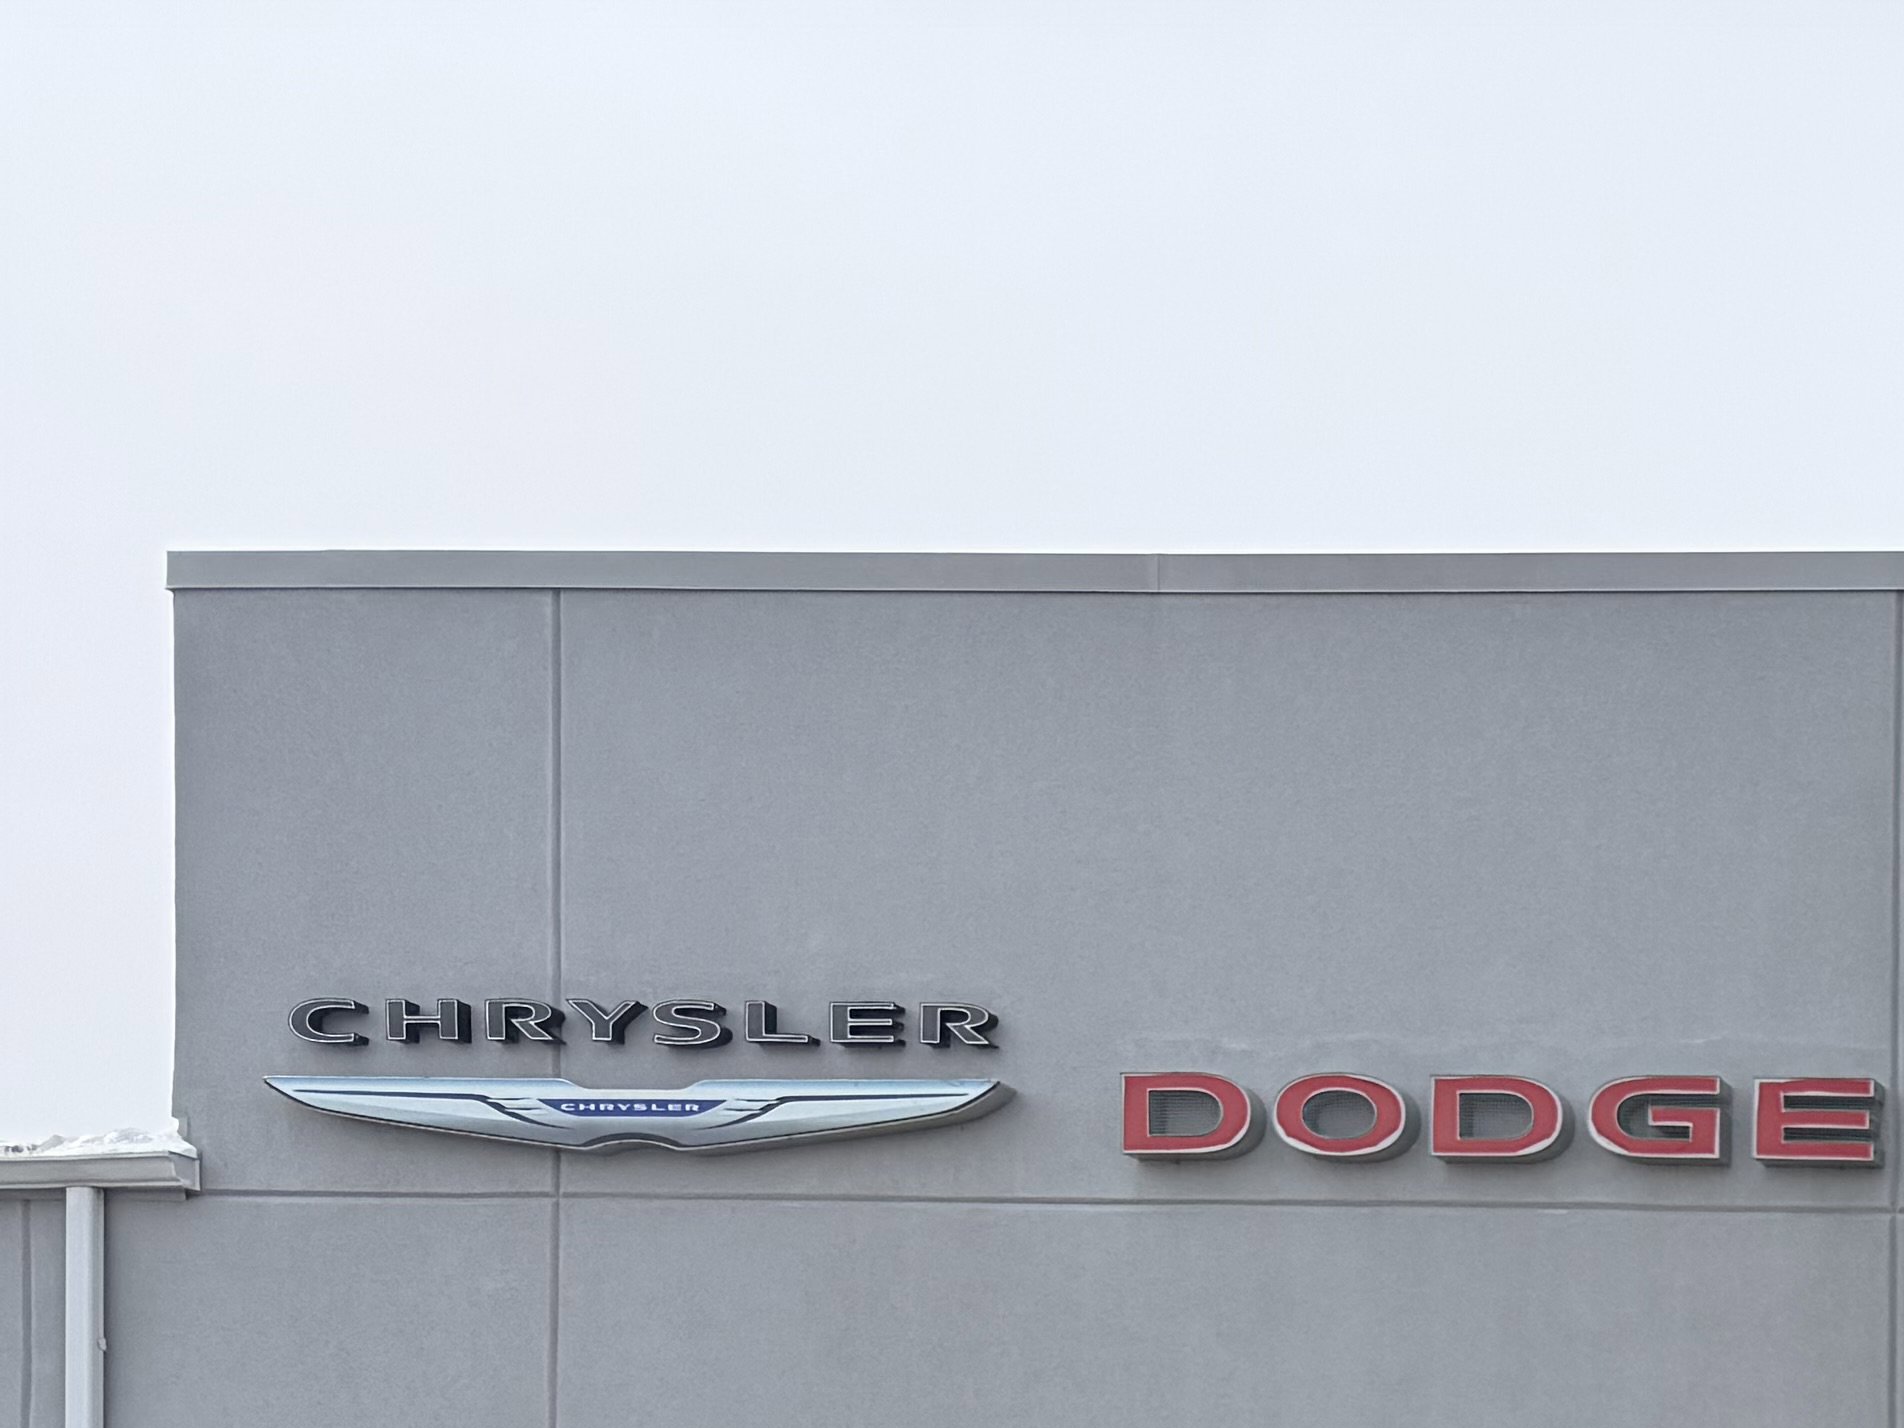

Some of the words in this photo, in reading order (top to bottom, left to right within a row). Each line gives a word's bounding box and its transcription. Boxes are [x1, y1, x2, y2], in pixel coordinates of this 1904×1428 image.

[289, 998, 1000, 1048] CHRYSLER
[560, 1103, 700, 1112] CHRYSLER
[1120, 1071, 1884, 1168] DODGE
